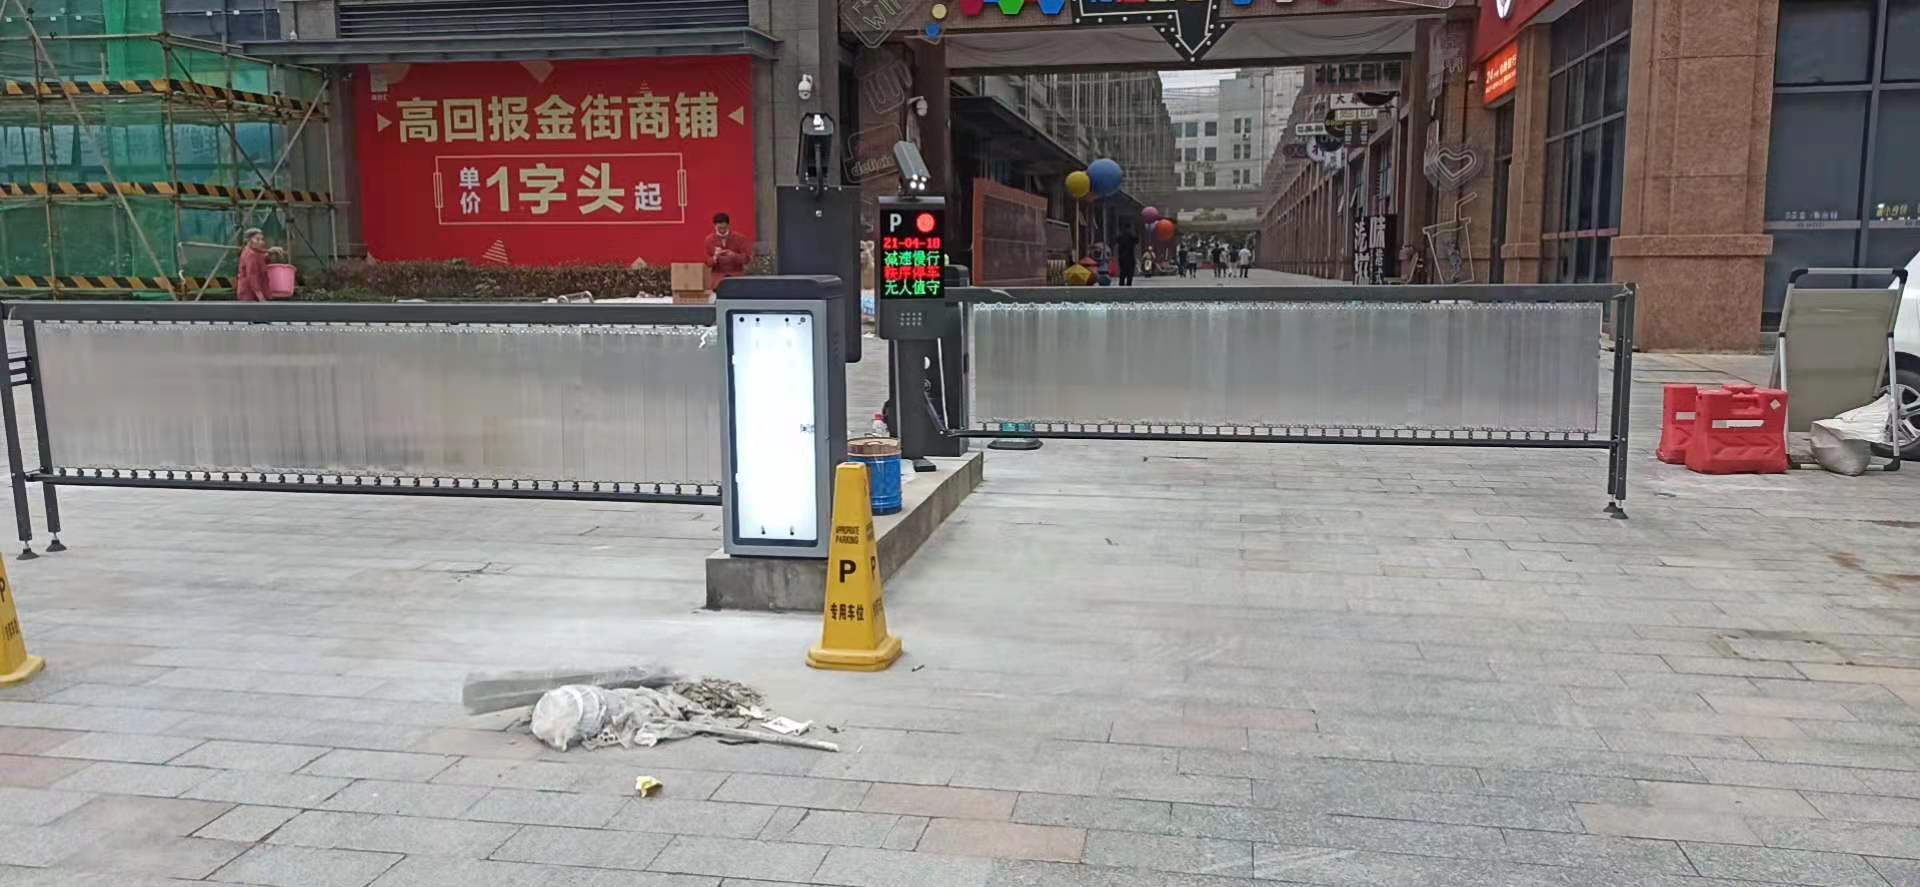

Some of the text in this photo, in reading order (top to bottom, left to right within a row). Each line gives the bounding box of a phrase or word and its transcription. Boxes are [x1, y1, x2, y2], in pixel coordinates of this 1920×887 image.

[396, 92, 719, 143] 高回报金街商铺
[458, 167, 481, 215] 单价
[889, 213, 903, 232] P
[884, 250, 941, 266] 减速慢行
[884, 266, 941, 280] 秩序停车
[884, 279, 941, 295] 无人值守
[835, 535, 859, 545] PARKING
[839, 559, 857, 583] P
[830, 602, 865, 621] 专用车位
